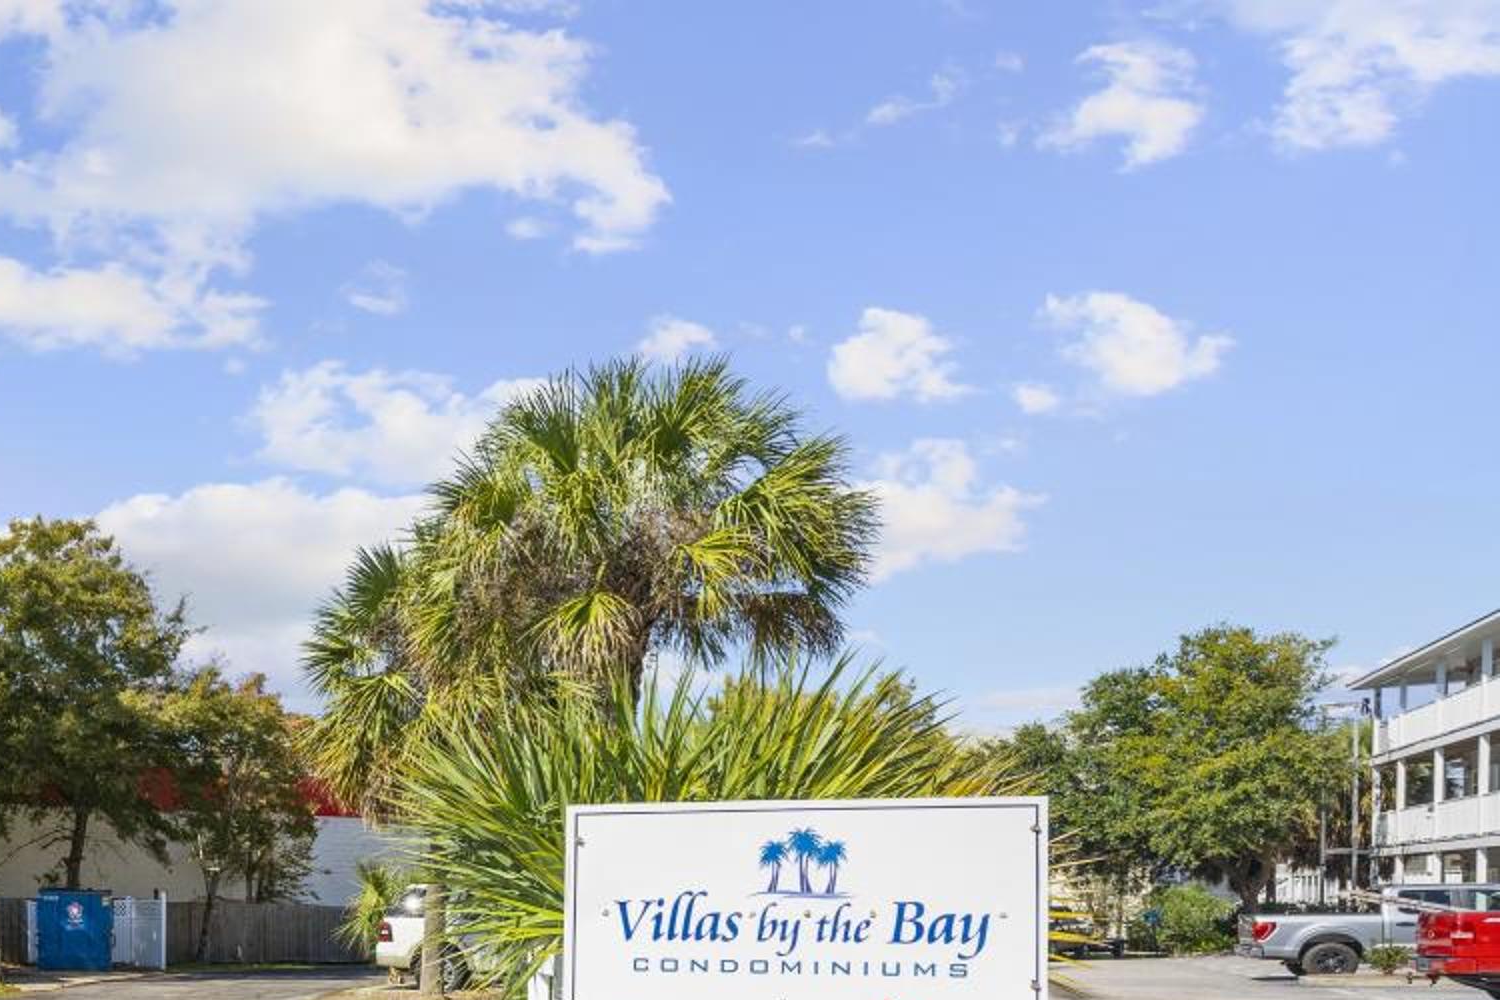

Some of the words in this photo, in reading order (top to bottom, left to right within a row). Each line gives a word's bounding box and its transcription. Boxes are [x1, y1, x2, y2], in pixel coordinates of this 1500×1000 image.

[614, 891, 743, 944] Villas
[754, 901, 802, 957] by
[815, 901, 873, 945] the
[886, 899, 992, 961] Bay
[632, 957, 969, 979] CONDOMINIUMS
